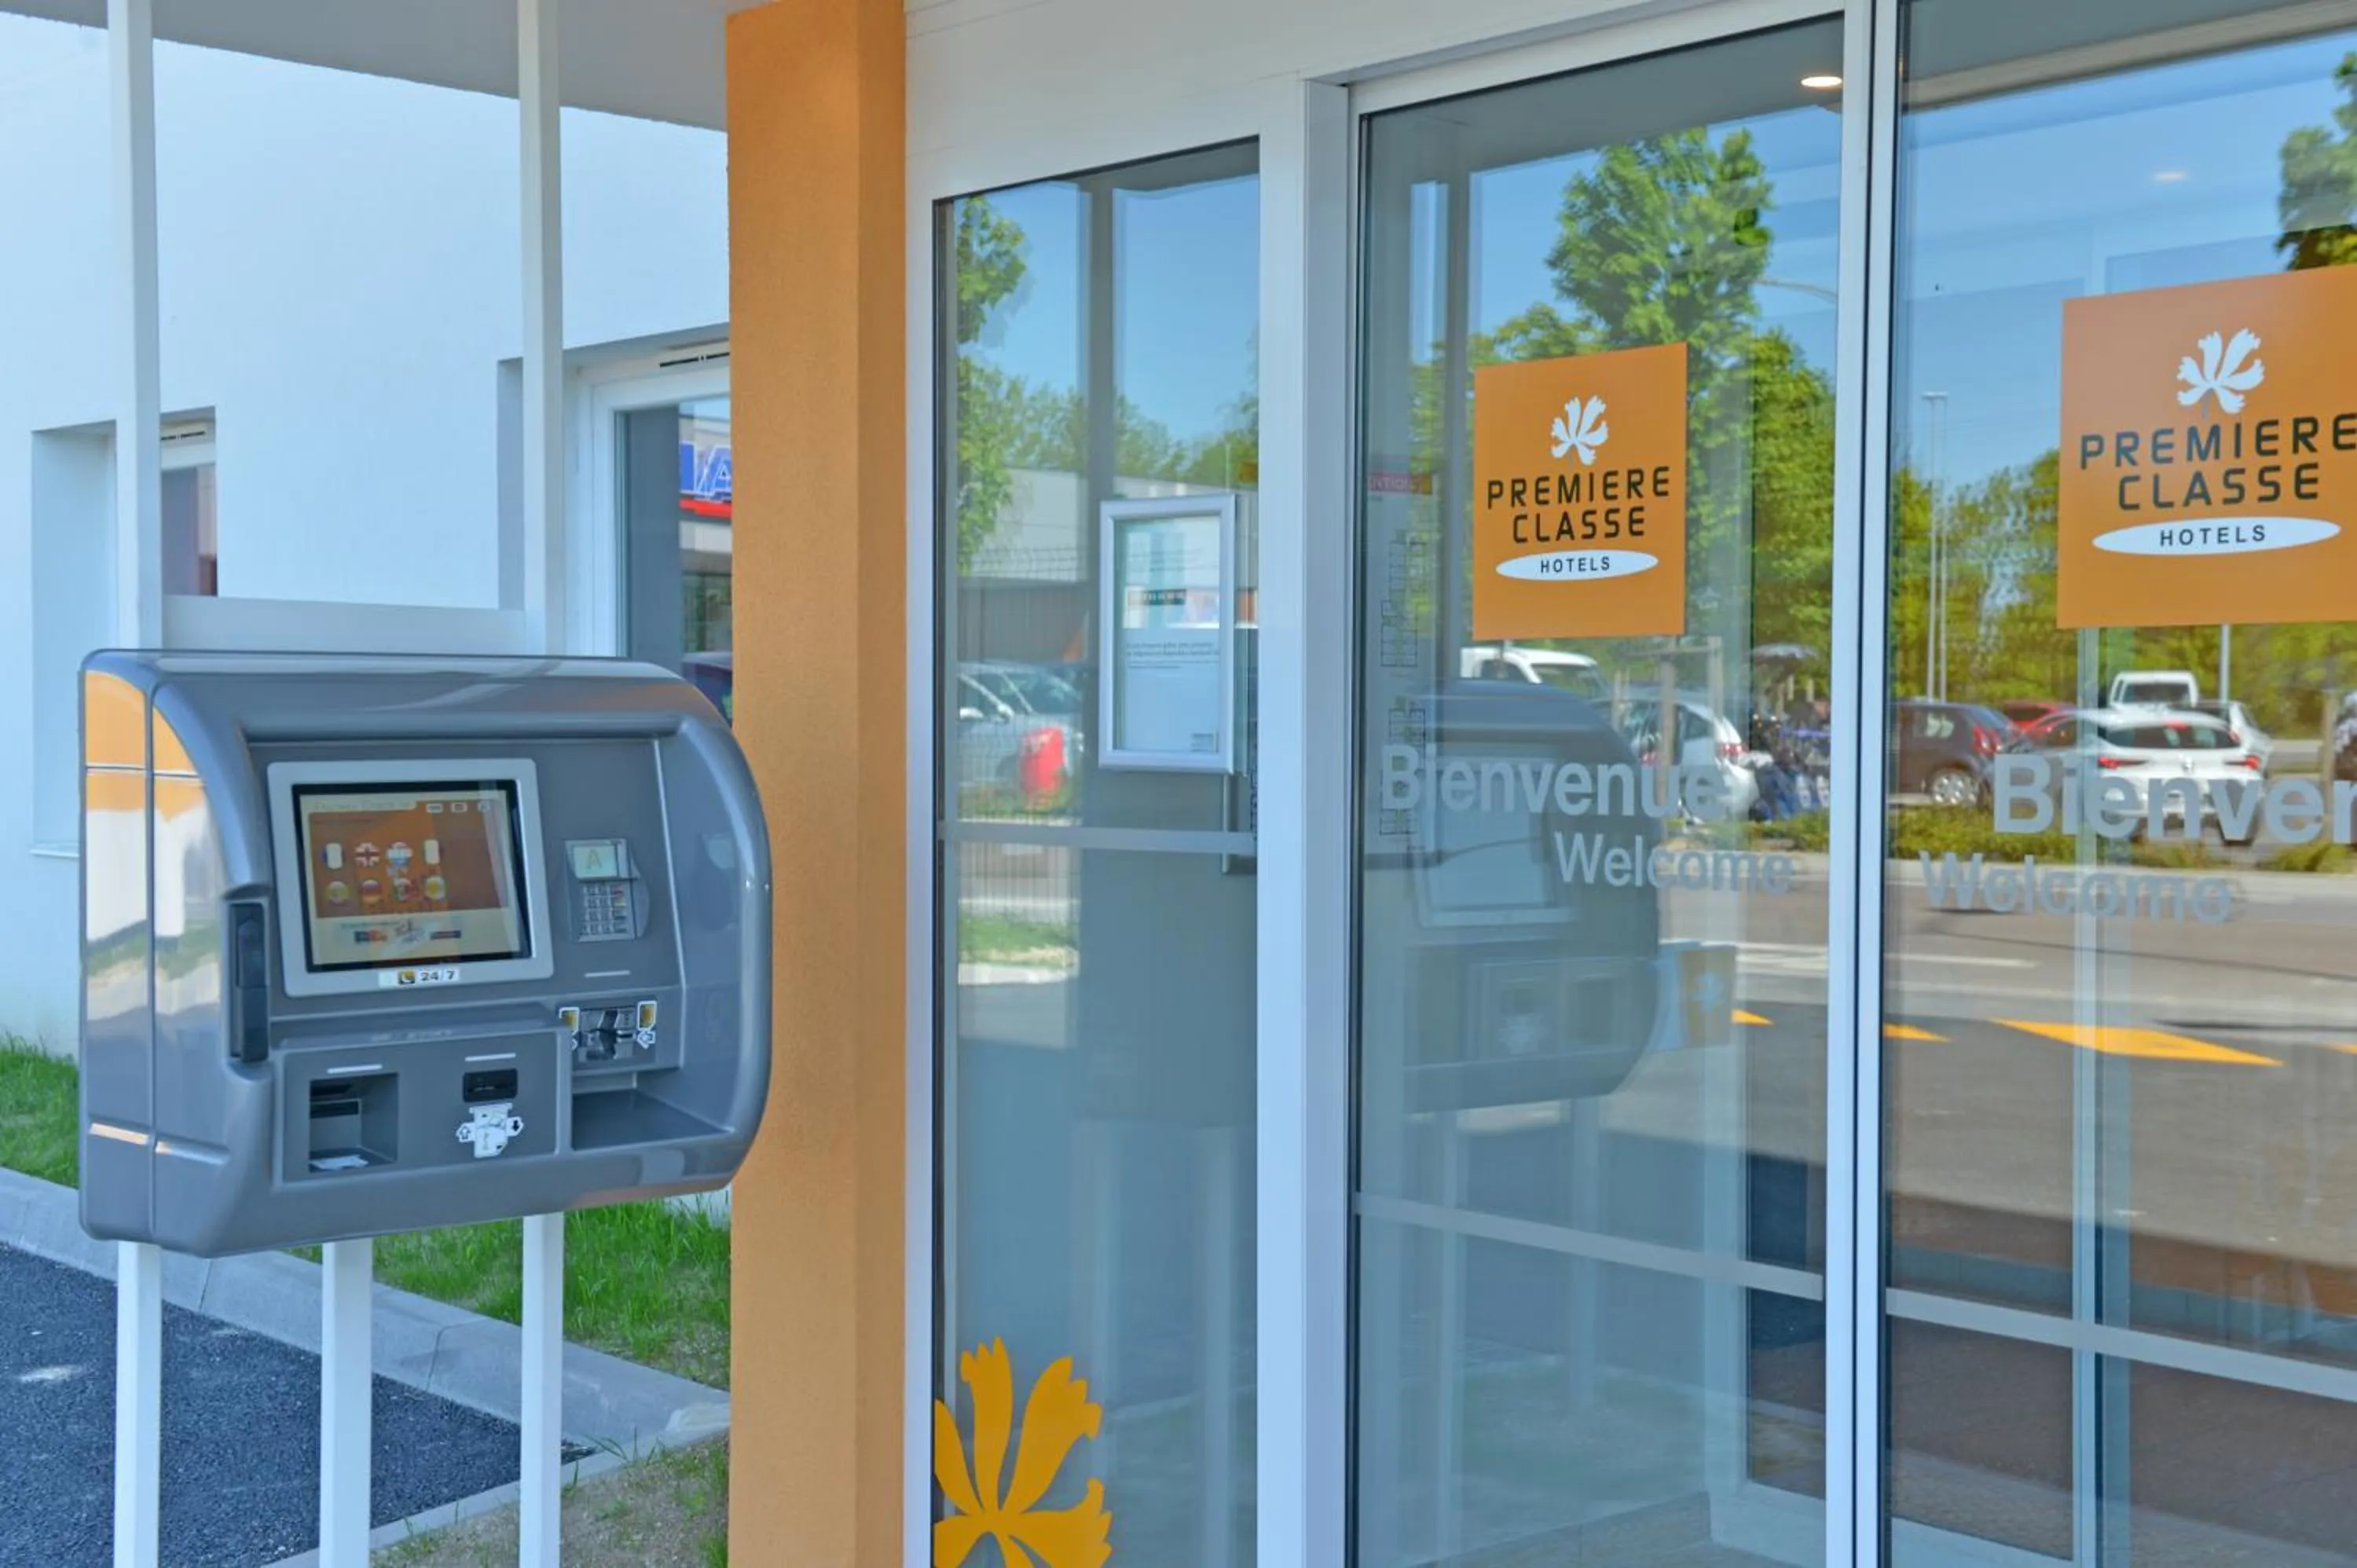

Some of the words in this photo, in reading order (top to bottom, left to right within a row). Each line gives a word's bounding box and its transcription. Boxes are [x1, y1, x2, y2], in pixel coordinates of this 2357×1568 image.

[2080, 413, 2357, 470] PREMIERE
[1487, 466, 1670, 509] PREMIERE
[2118, 463, 2319, 511] CLASSE
[1513, 506, 1645, 543] CLASSE
[2160, 525, 2266, 546] HOTELS
[1540, 556, 1611, 573] HOTELS
[1381, 744, 1727, 819] Bienvenue
[1554, 831, 1794, 893] Welcome
[1919, 849, 2235, 923] Welcome
